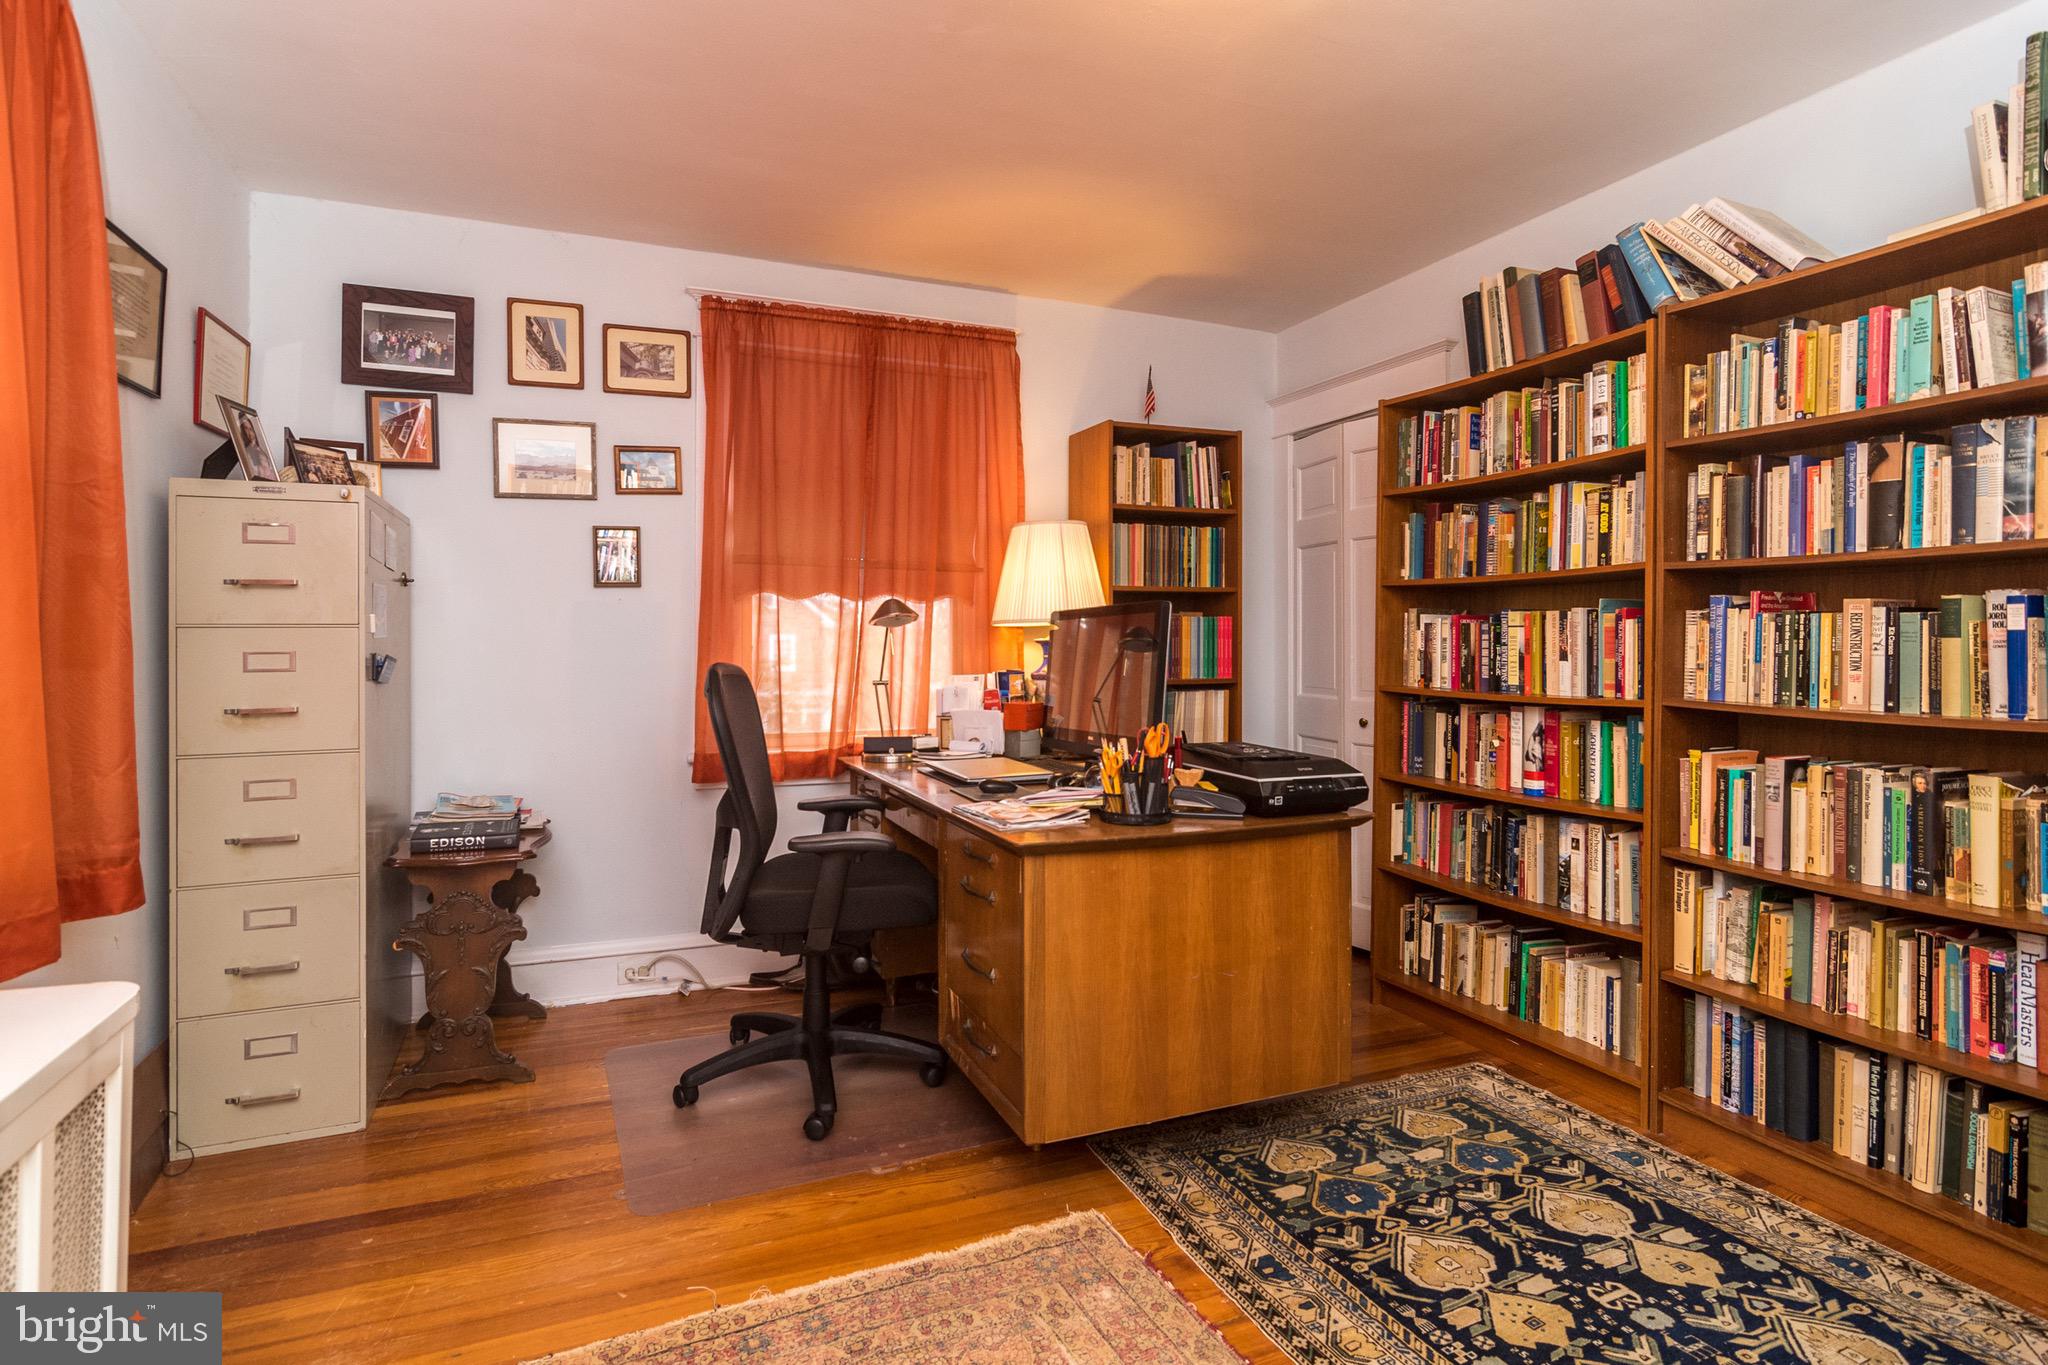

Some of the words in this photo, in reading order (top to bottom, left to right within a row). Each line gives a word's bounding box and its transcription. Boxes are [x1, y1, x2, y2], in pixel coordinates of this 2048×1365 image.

[2025, 133, 2039, 167] ATLAS
[1679, 225, 1709, 253] AMERICA
[1715, 251, 1743, 275] DESIGN
[1848, 453, 1856, 461] The
[1600, 503, 1609, 513] AT
[1600, 513, 1609, 534] ODDS
[1888, 626, 1896, 635] Kit
[1849, 613, 1863, 673] RECONSTRUCTION
[1888, 635, 1896, 656] Carson
[430, 836, 486, 848] EDISON
[1676, 879, 1684, 892] God's
[1676, 892, 1684, 912] Dangers
[1829, 936, 1837, 944] The
[1829, 944, 1837, 957] Killer
[2021, 951, 2040, 989] Head
[2020, 990, 2037, 1047] Masters
[1869, 1095, 1880, 1117] Together
[1969, 1112, 1978, 1134] SOCIAL
[1967, 1134, 1977, 1170] DARWINISM
